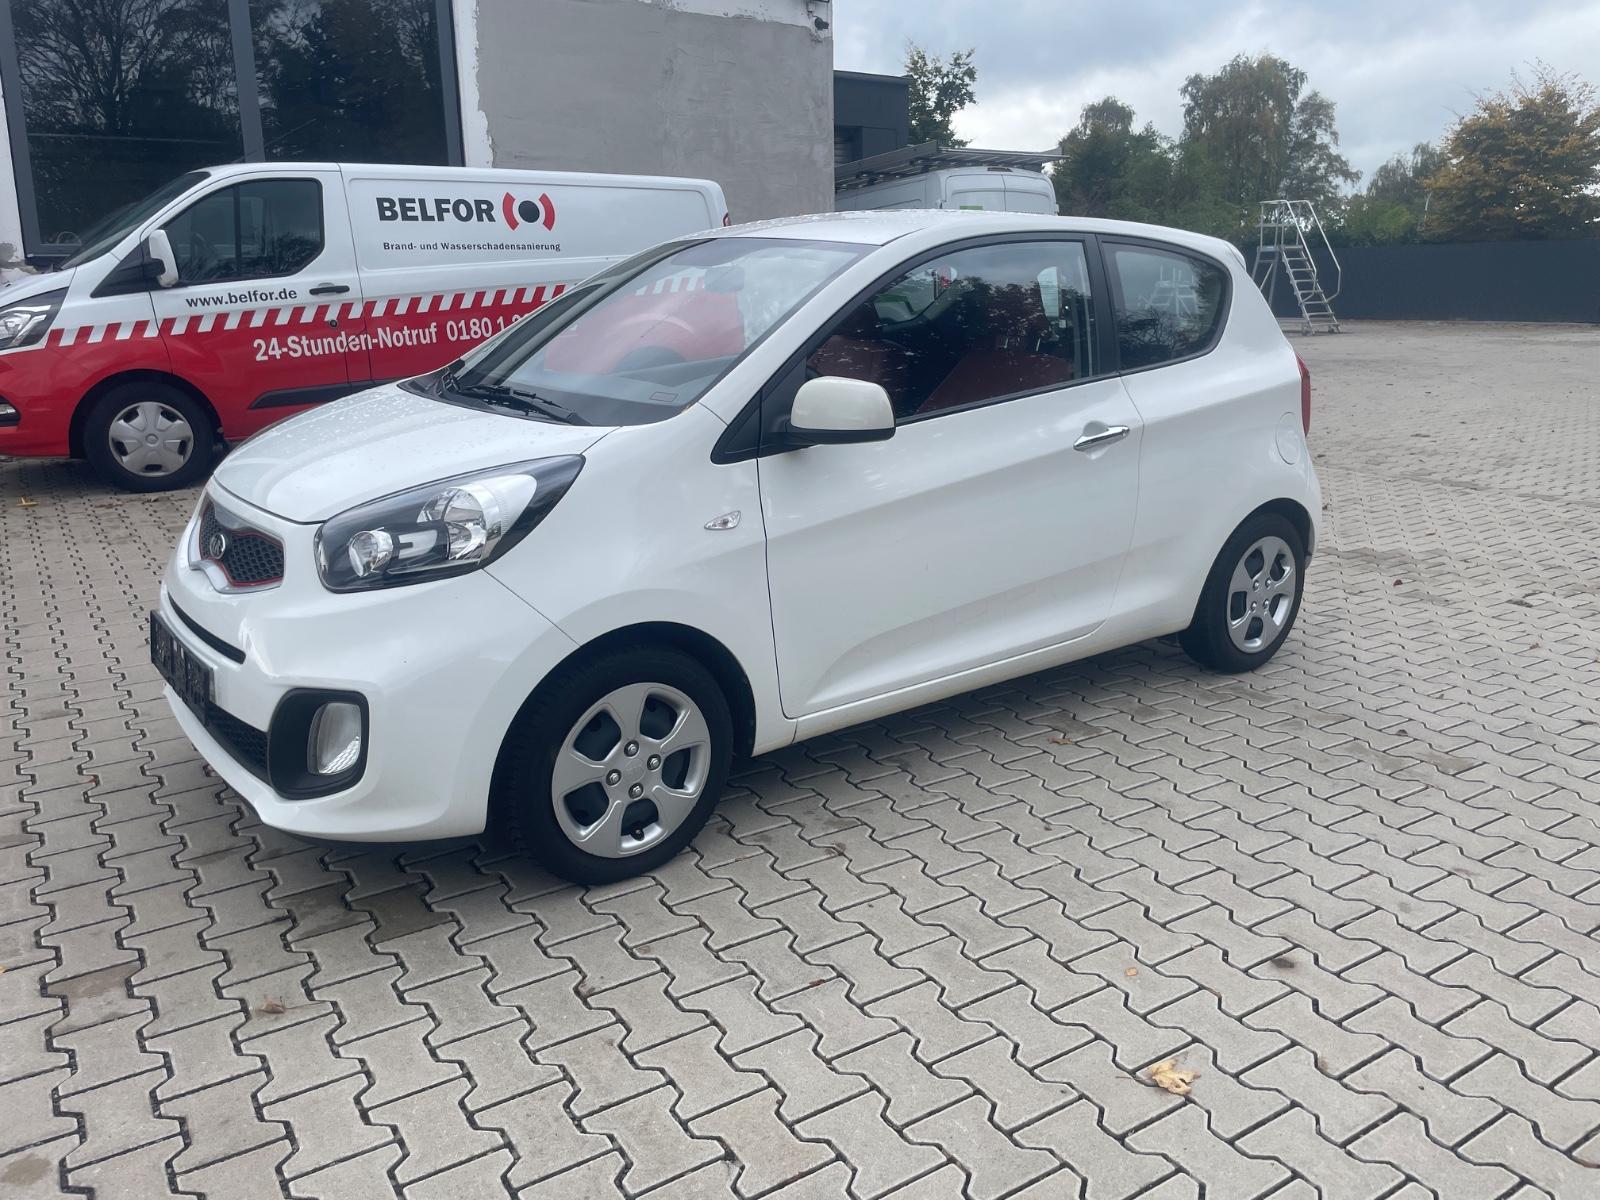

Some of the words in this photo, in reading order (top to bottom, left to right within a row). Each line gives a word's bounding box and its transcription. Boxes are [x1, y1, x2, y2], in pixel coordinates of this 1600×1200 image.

[376, 197, 496, 223] BELFOR
[383, 242, 417, 251] Brand-
[420, 242, 438, 251] und
[440, 242, 561, 252] Wasserschadensanierung
[186, 288, 298, 308] www.belfor.de
[253, 322, 437, 362] 24-Stunden-Notruf
[446, 316, 493, 342] 0180
